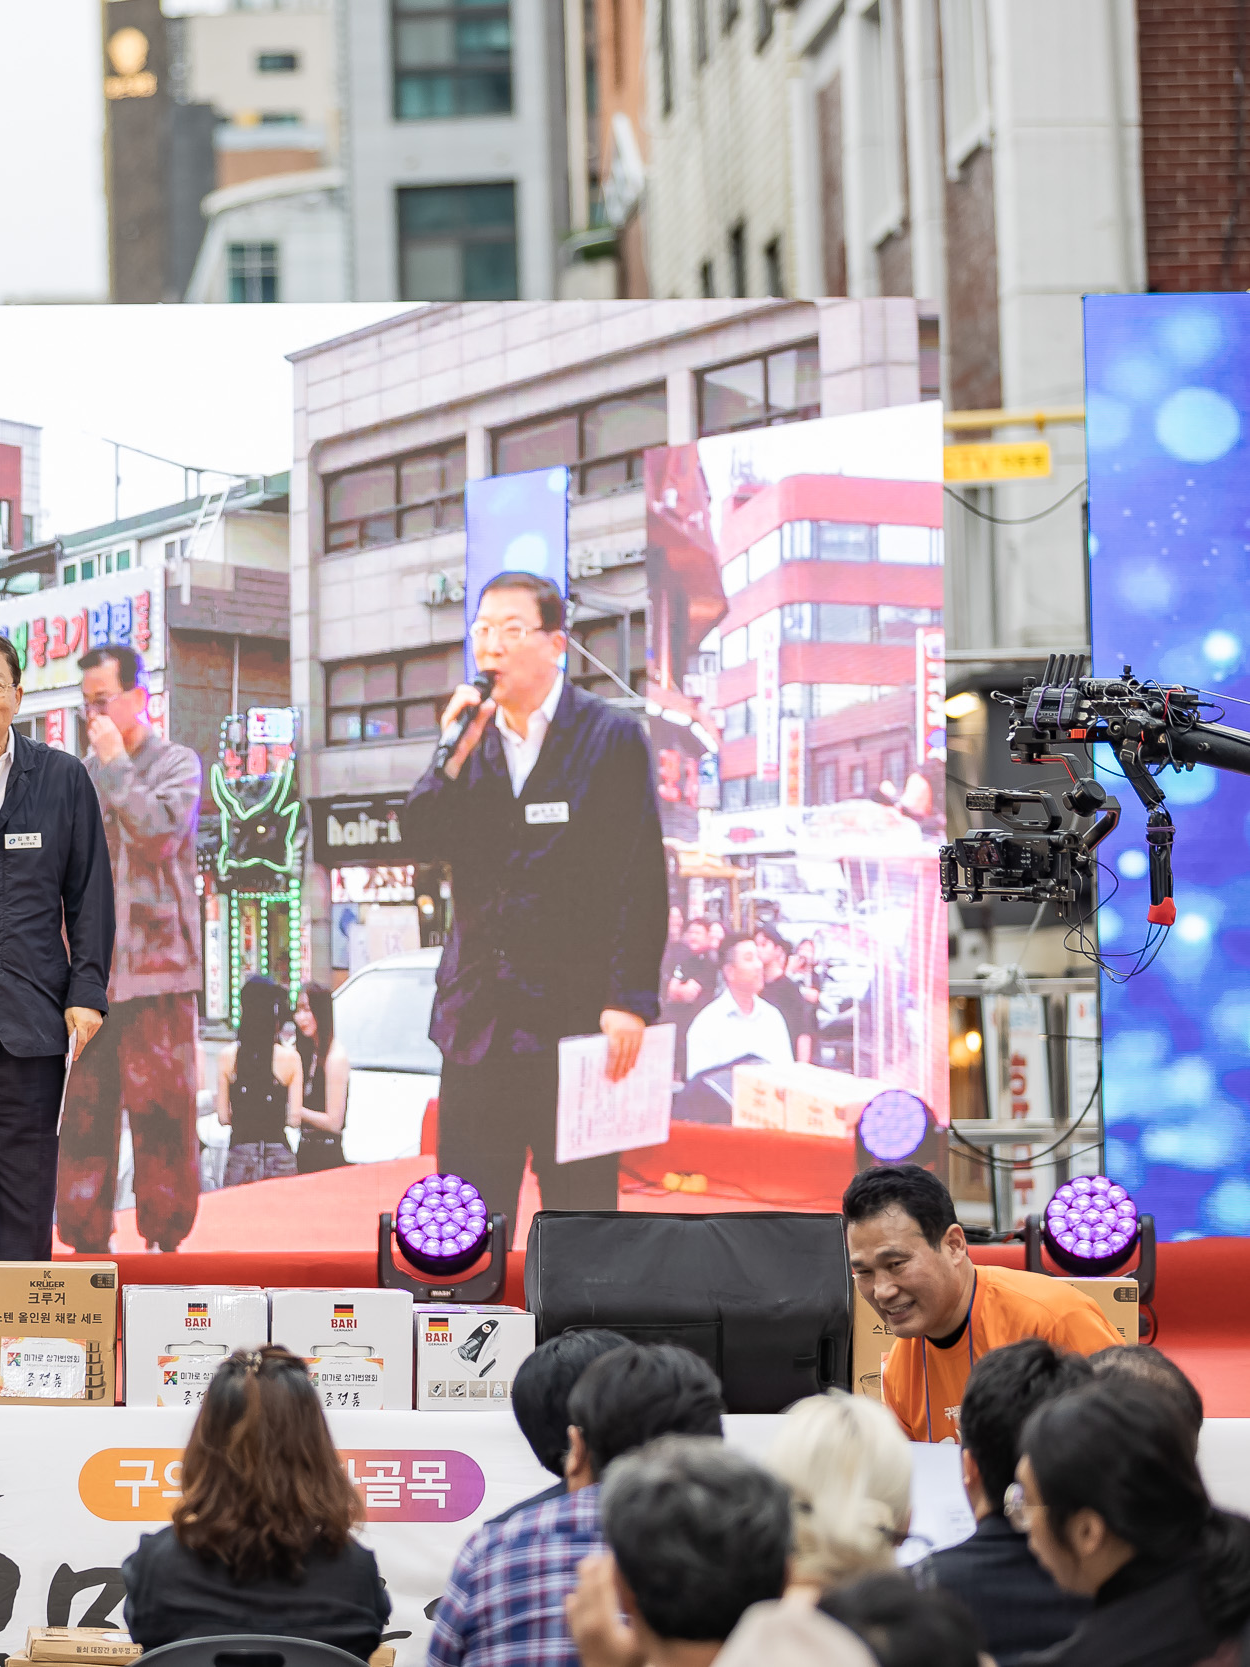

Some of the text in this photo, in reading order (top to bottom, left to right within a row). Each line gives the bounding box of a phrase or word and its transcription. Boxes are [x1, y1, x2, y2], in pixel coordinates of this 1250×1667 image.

[29, 1279, 65, 1288] KRÜGER
[28, 1292, 66, 1306] 크루거
[17, 1312, 51, 1324] 올인원
[54, 1312, 77, 1325] 채칼
[81, 1312, 103, 1324] 세트
[184, 1317, 212, 1328] BARI
[330, 1318, 358, 1329] BARI
[425, 1332, 453, 1343] BARI
[23, 1353, 80, 1364] 미가로 상가번영회
[180, 1371, 201, 1381] 미가로
[321, 1373, 378, 1383] 미가로 상가번영회
